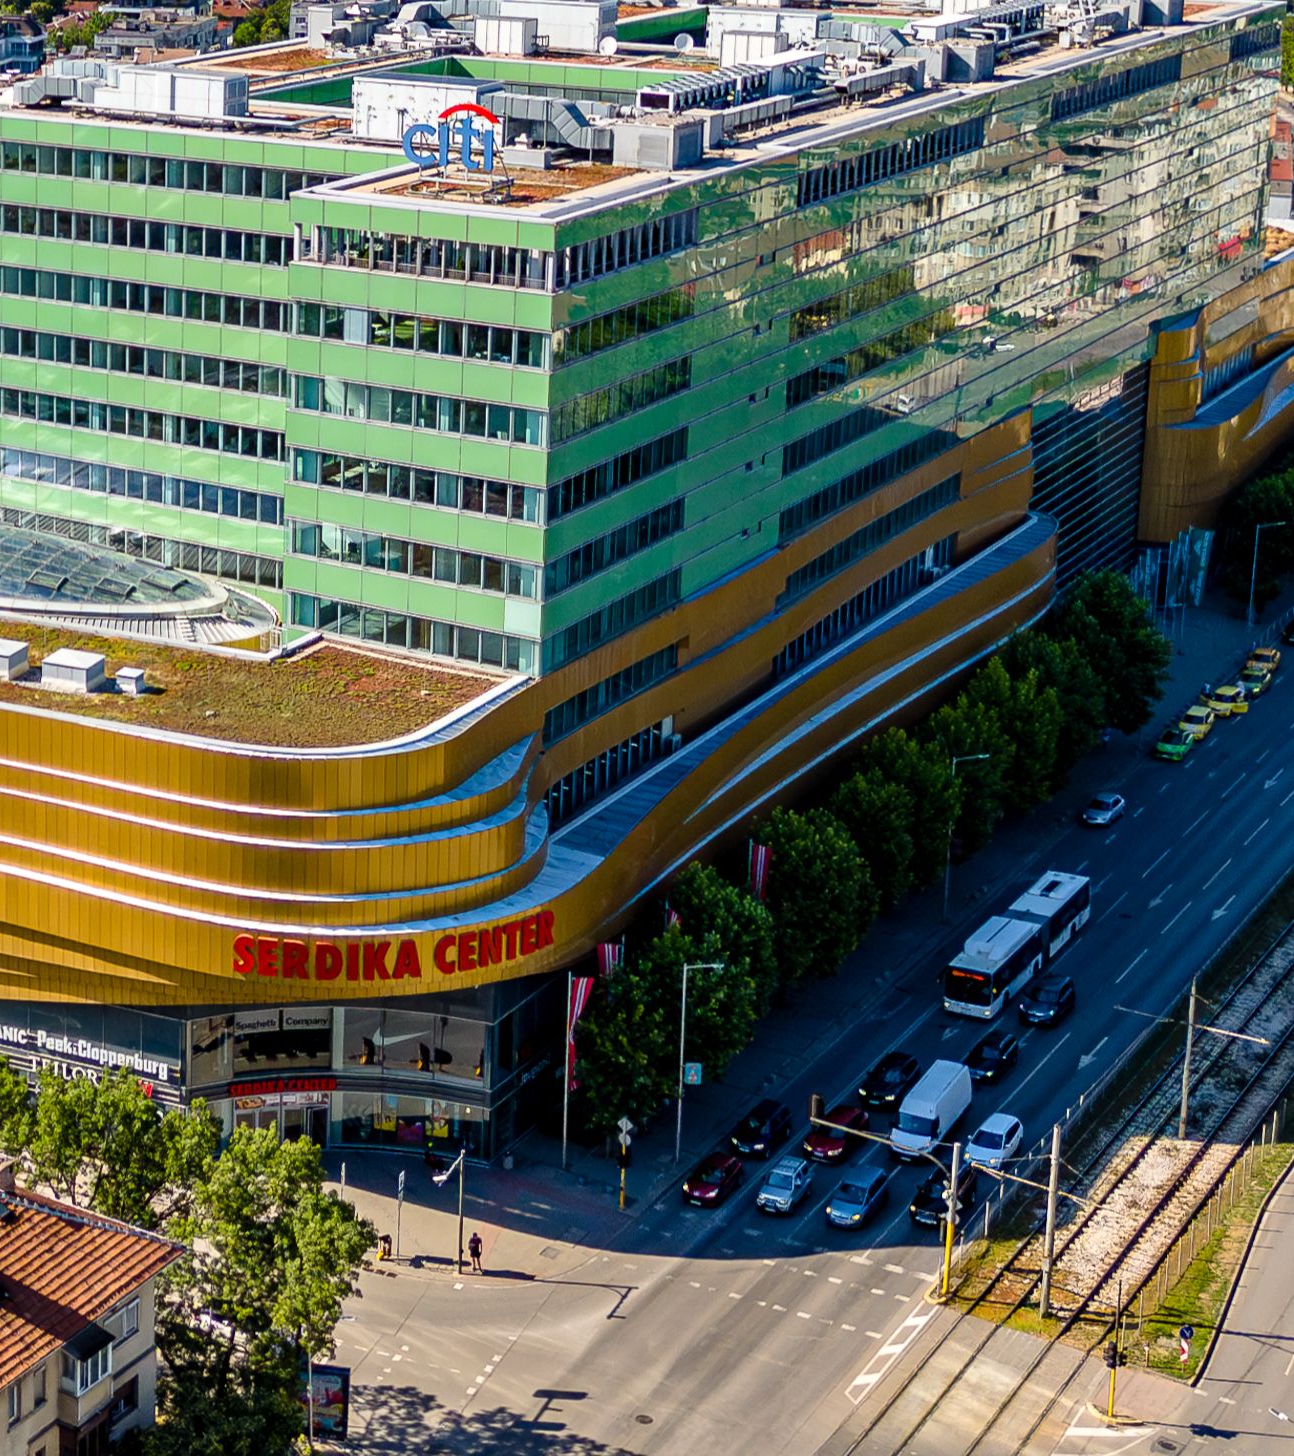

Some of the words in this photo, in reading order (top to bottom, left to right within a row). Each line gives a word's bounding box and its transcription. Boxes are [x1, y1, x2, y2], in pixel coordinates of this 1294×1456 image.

[402, 115, 494, 171] citi
[233, 932, 422, 981] SERDIKA
[434, 910, 555, 974] CENTER
[235, 1018, 276, 1030] Spaghetti
[285, 1016, 329, 1027] Company
